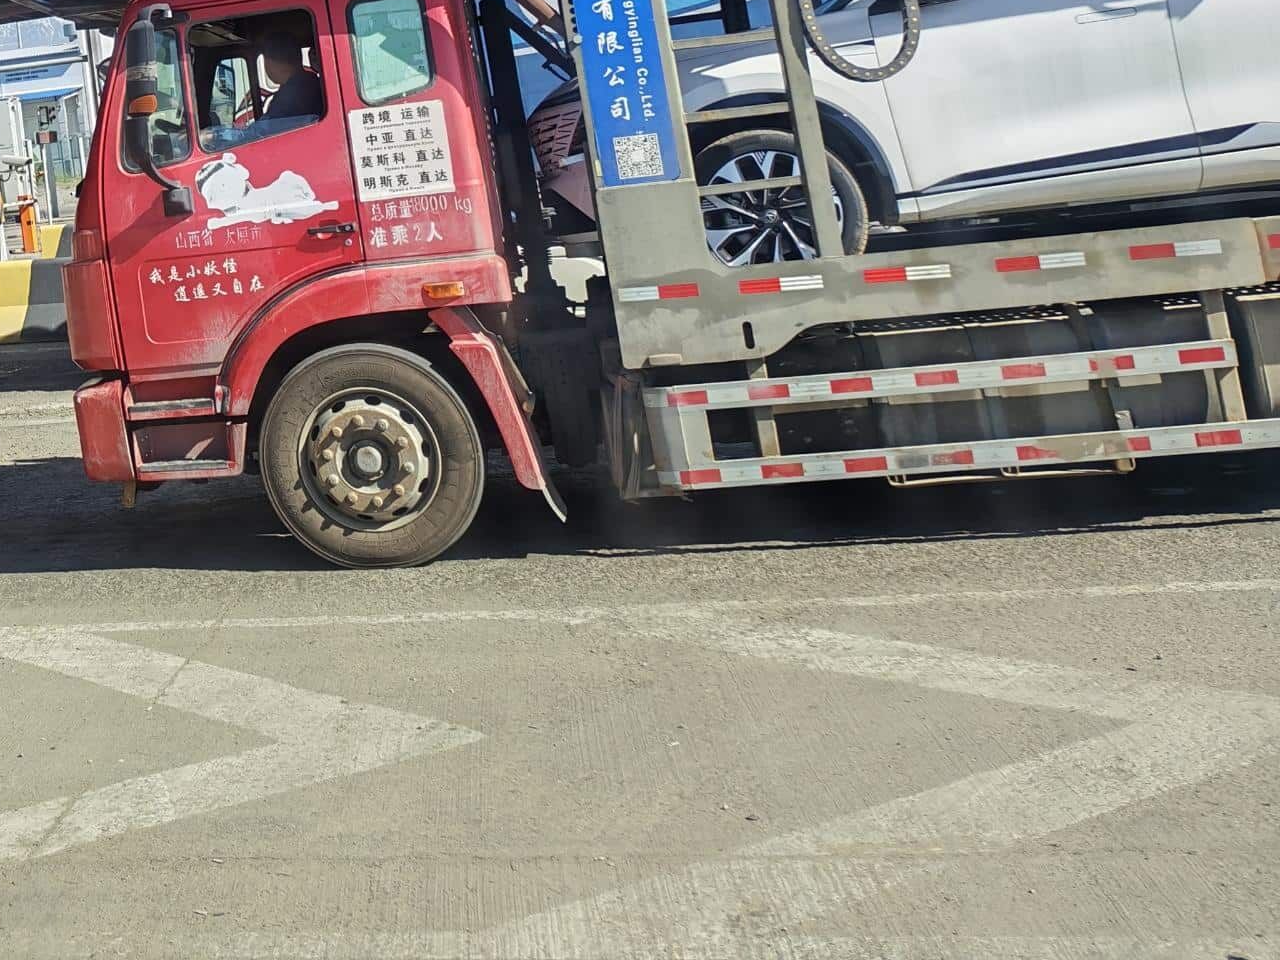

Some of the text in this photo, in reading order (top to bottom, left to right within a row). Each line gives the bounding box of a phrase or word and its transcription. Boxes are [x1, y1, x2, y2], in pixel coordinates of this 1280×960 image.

[362, 105, 430, 125] 跨境 运输
[365, 127, 433, 146] 中亚 直达
[360, 151, 406, 168] 莫斯科
[416, 147, 444, 162] 直达
[363, 174, 409, 190] 明斯克
[418, 168, 448, 184] 直达
[454, 196, 472, 213] kg
